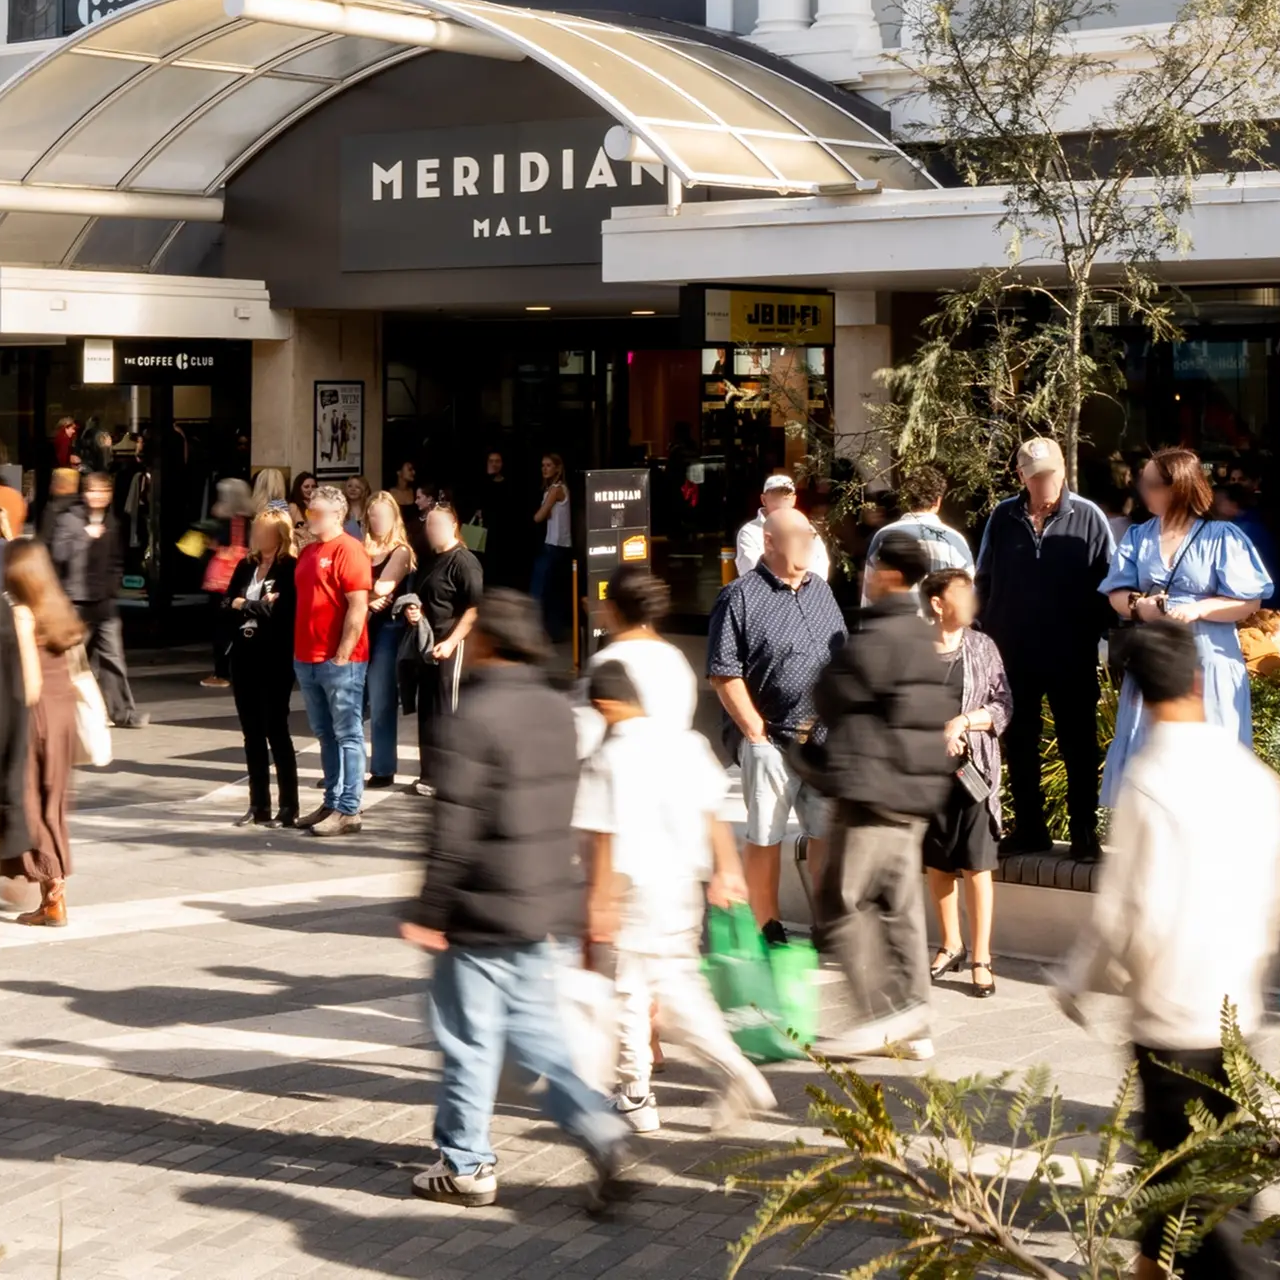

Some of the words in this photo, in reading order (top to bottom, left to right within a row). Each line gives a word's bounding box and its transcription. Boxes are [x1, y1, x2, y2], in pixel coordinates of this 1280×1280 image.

[372, 146, 665, 201] MERIDIAN
[473, 215, 552, 238] MALL
[747, 303, 775, 325] JB
[124, 357, 136, 365] THE
[137, 356, 173, 366] COFFEE
[190, 356, 214, 366] CLUB
[594, 489, 641, 502] MERIDIAN
